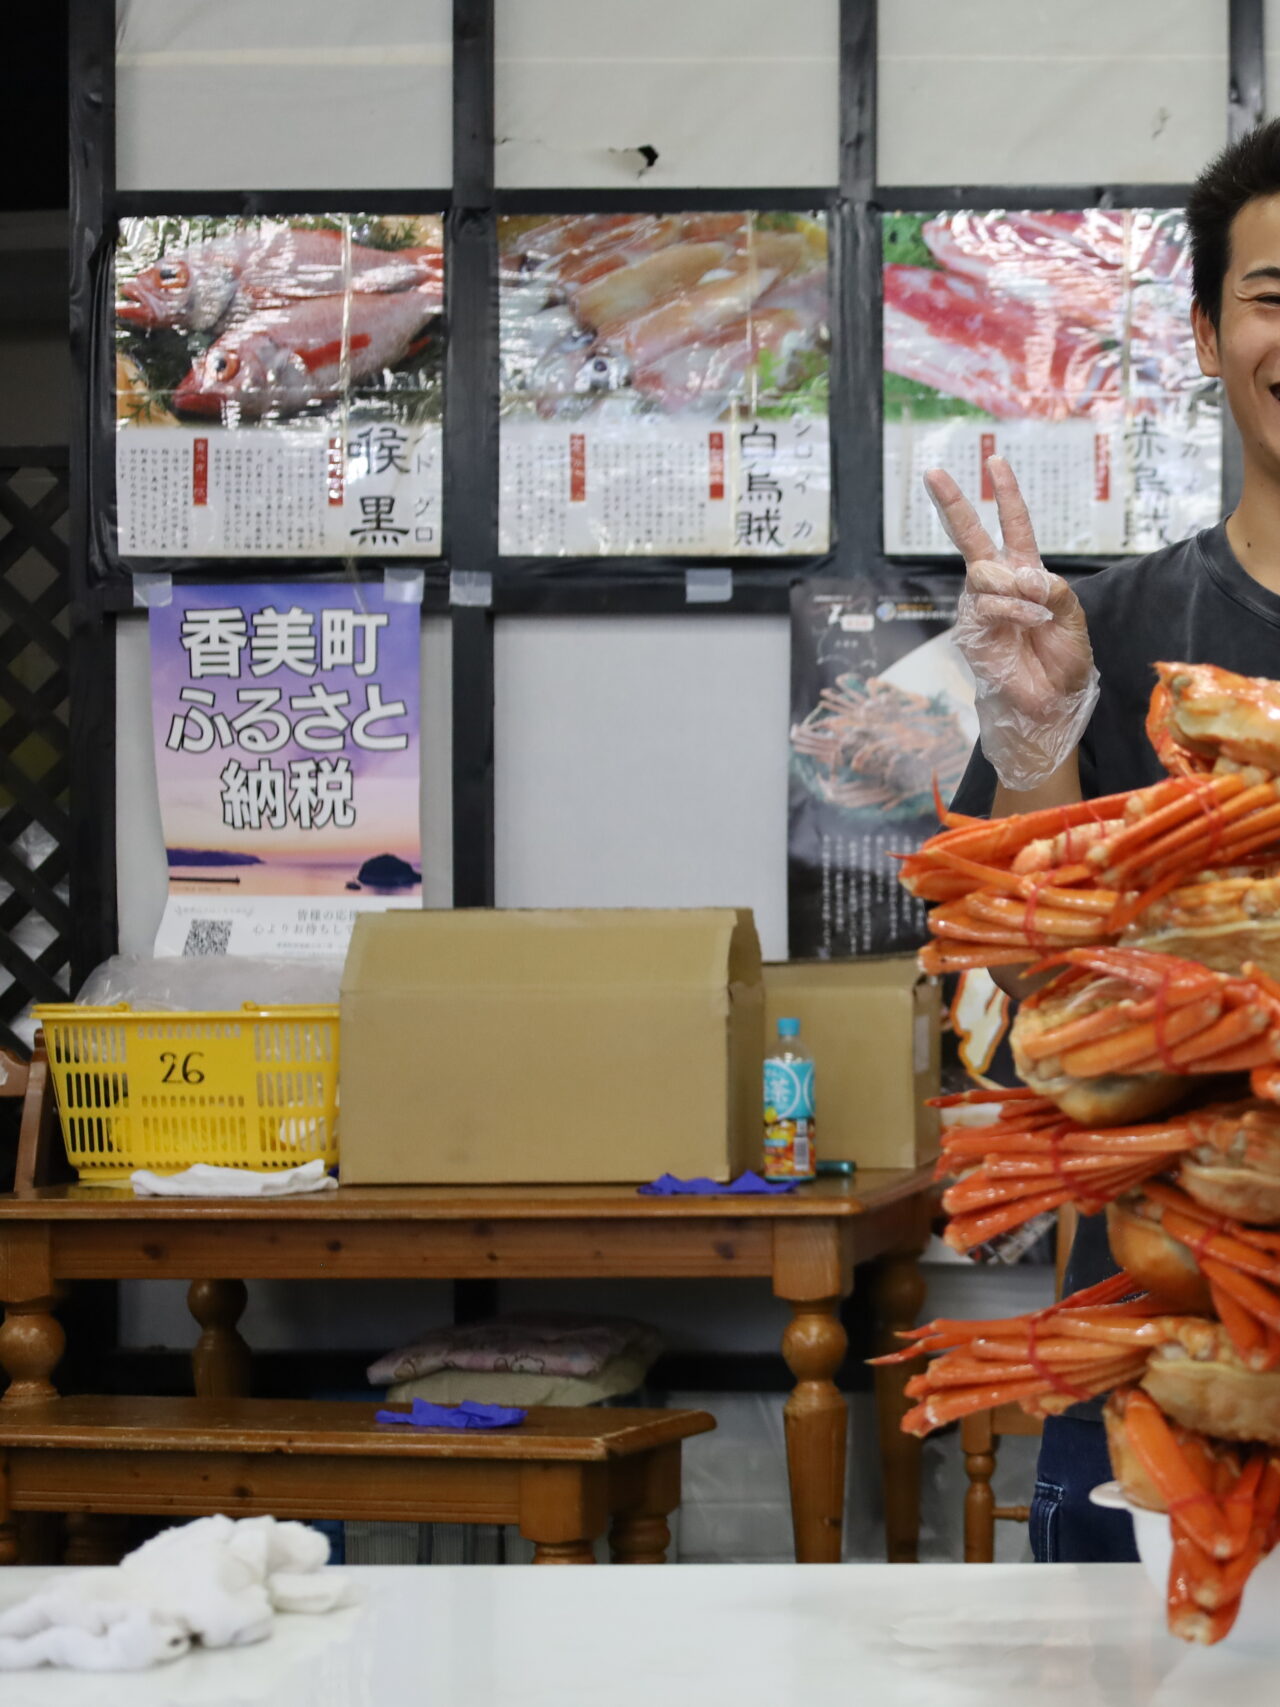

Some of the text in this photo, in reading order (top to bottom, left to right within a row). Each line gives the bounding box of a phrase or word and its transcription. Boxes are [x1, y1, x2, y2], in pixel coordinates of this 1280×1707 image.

[180, 607, 390, 679] 香美町
[166, 683, 409, 754] ふるさと
[220, 758, 356, 830] 納税
[160, 1052, 205, 1085] 26
